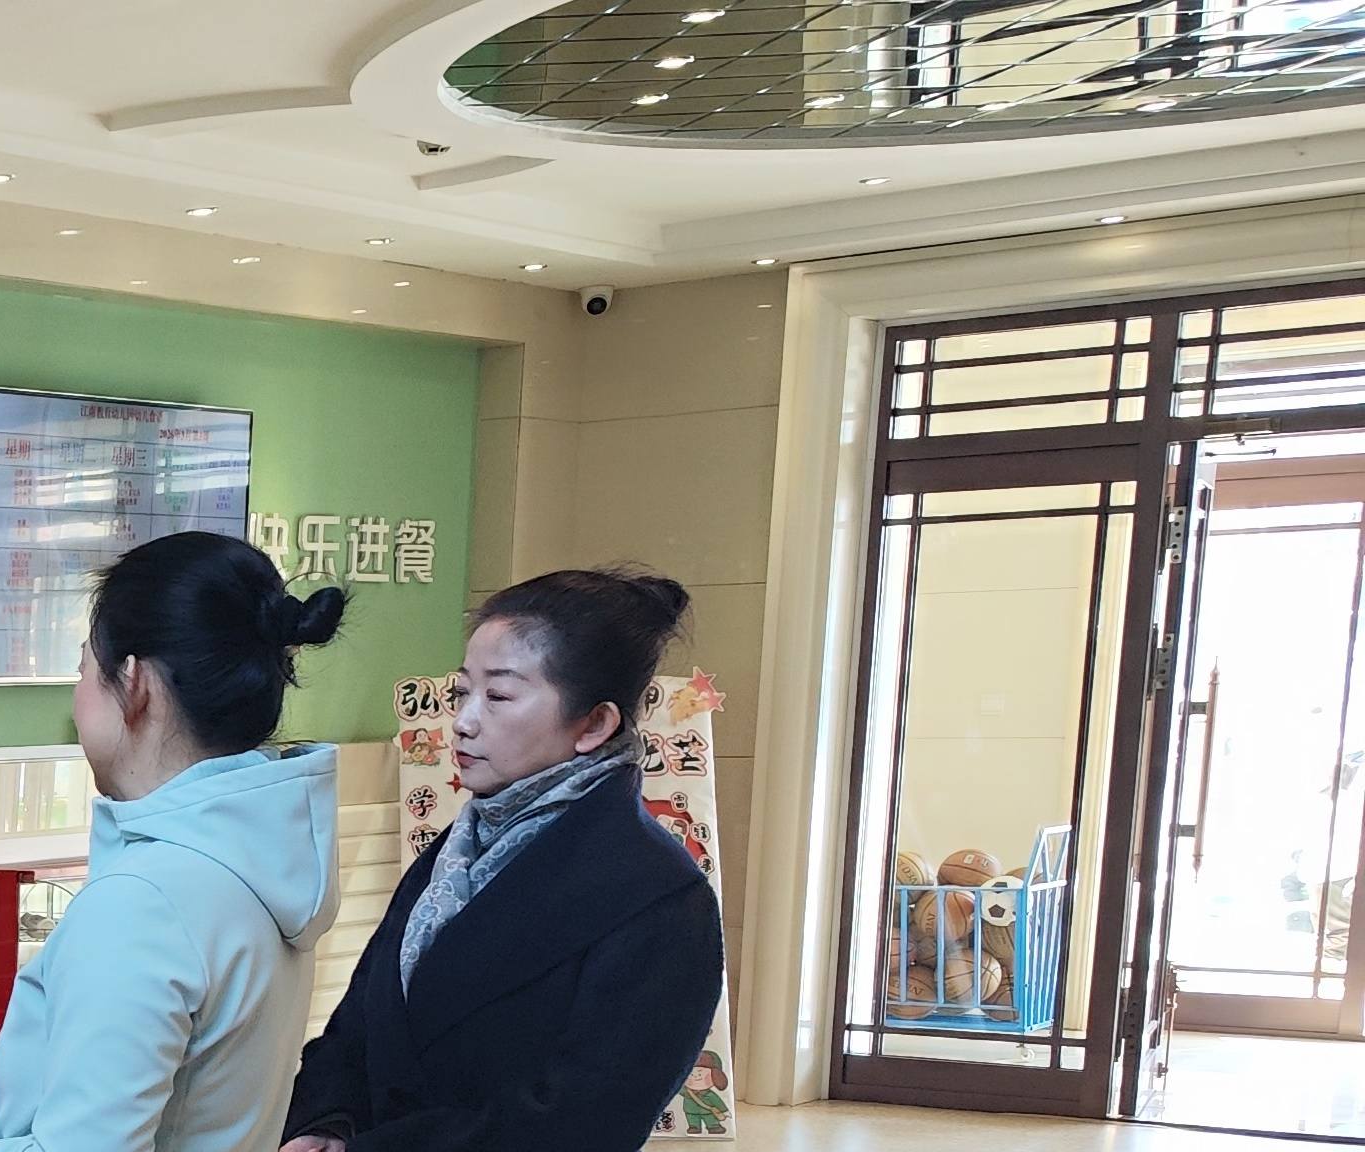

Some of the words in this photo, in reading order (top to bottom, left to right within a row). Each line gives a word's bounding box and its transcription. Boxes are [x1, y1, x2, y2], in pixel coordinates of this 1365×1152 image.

[111, 446, 147, 468] 星期三
[249, 513, 435, 583] 快乐进餐
